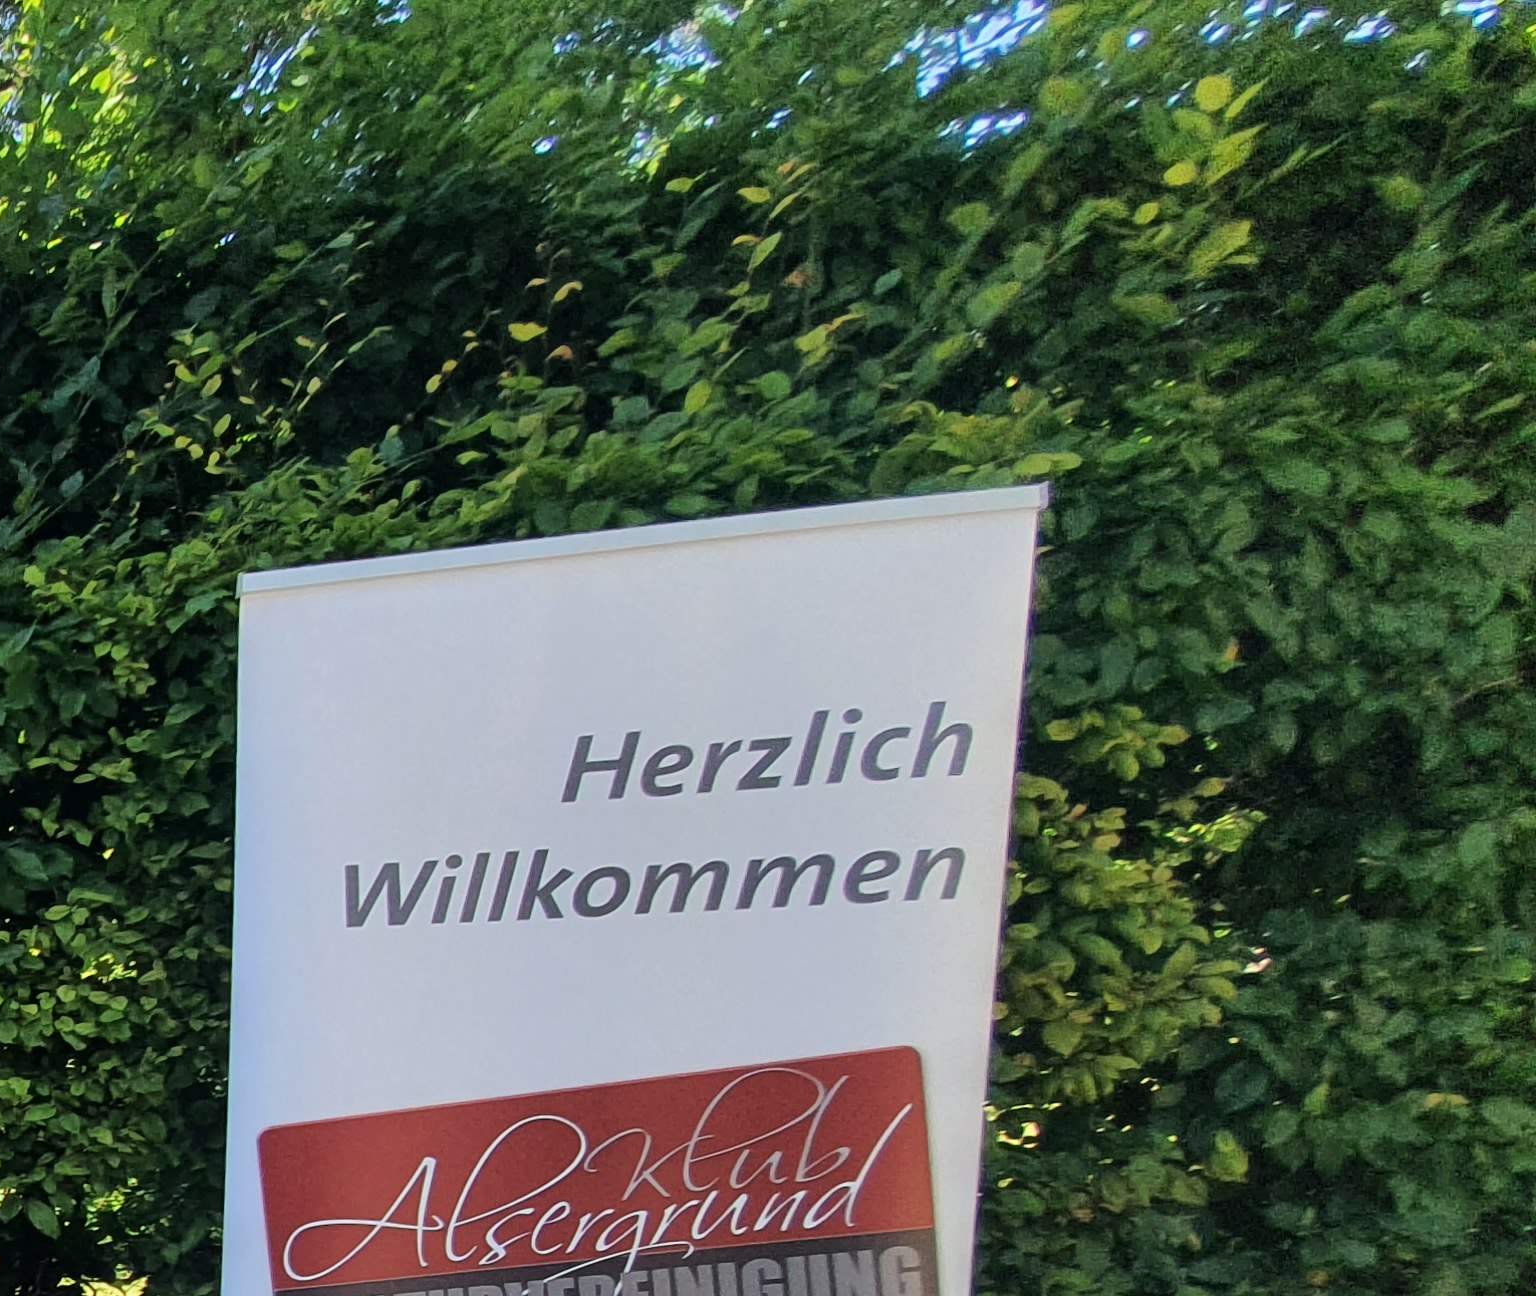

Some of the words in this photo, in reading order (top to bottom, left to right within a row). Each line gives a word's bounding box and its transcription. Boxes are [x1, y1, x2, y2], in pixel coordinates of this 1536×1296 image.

[561, 701, 974, 804] Herzlich
[343, 844, 967, 928] Willkommen
[582, 1066, 850, 1201] Klub
